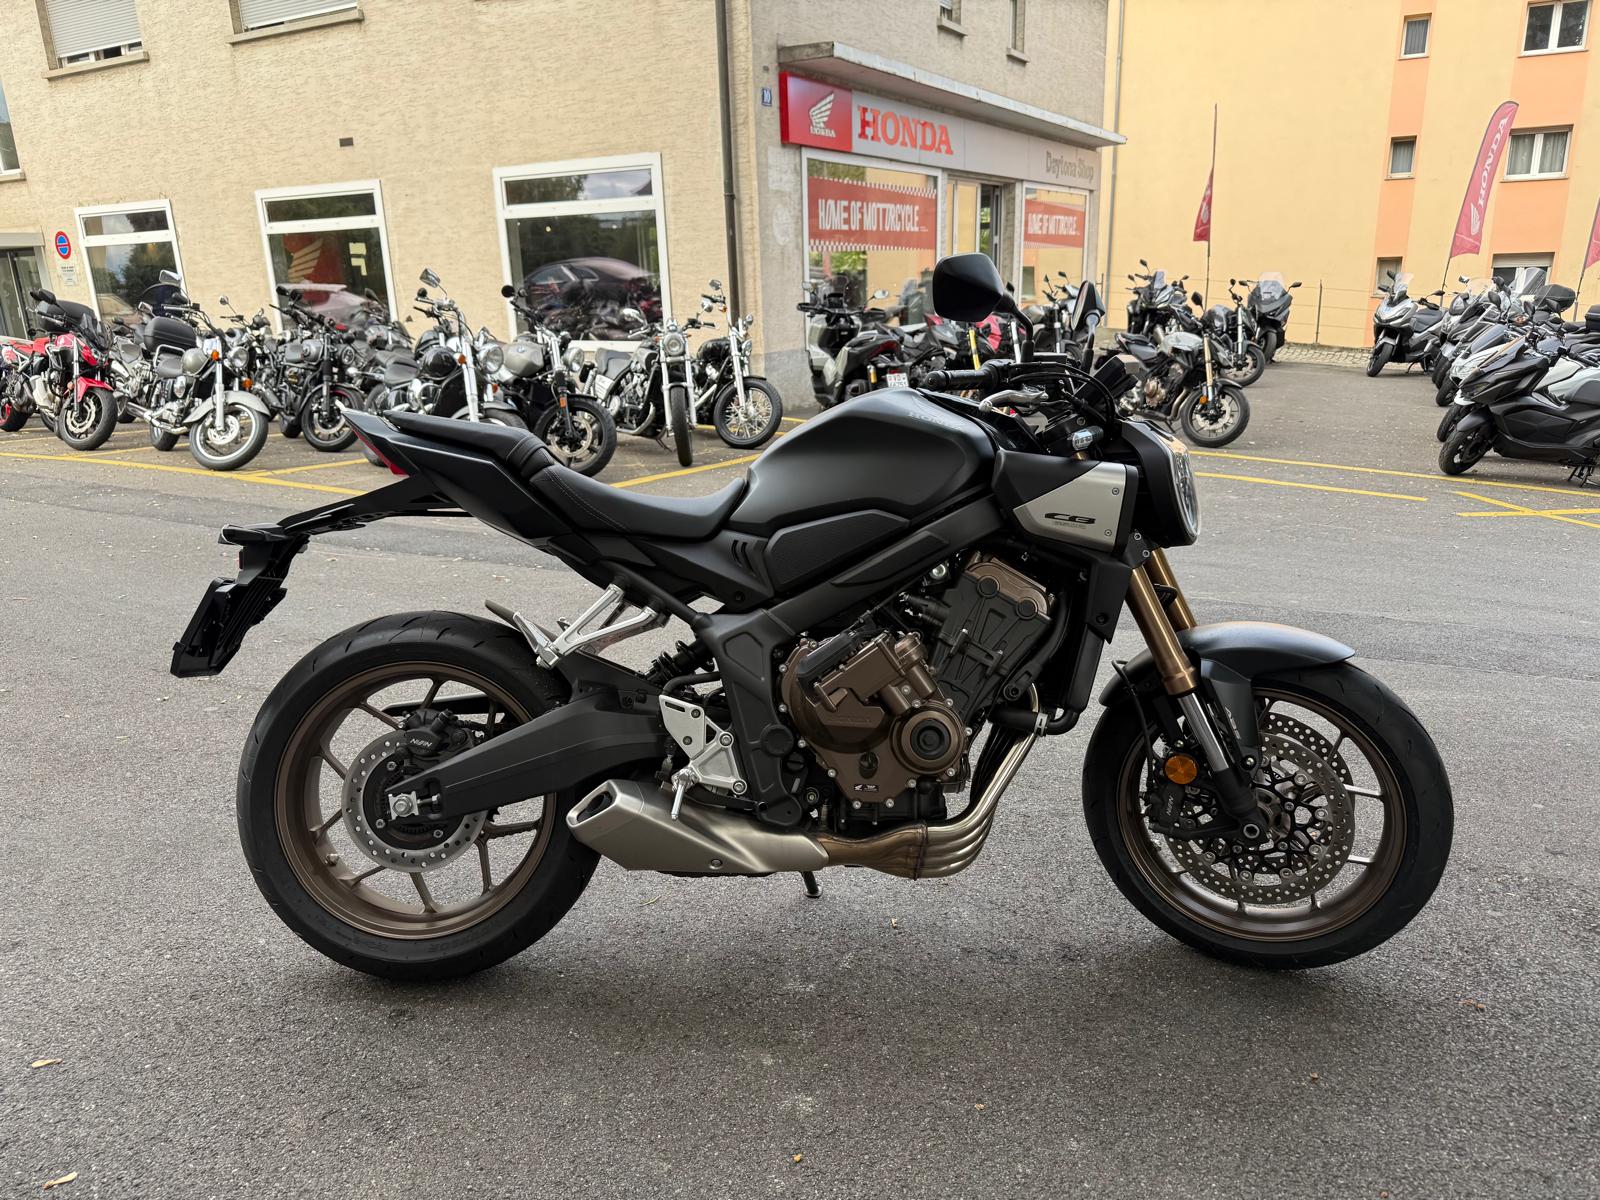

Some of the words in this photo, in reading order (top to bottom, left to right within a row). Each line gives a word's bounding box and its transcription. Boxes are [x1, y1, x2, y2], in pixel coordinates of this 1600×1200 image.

[858, 105, 954, 155] HONDA
[1046, 150, 1077, 178] Daytona
[1077, 158, 1095, 182] Shop
[1478, 116, 1509, 208] HONDA
[818, 198, 849, 231] HOME
[850, 201, 862, 232] OF
[1044, 512, 1096, 524] CB
